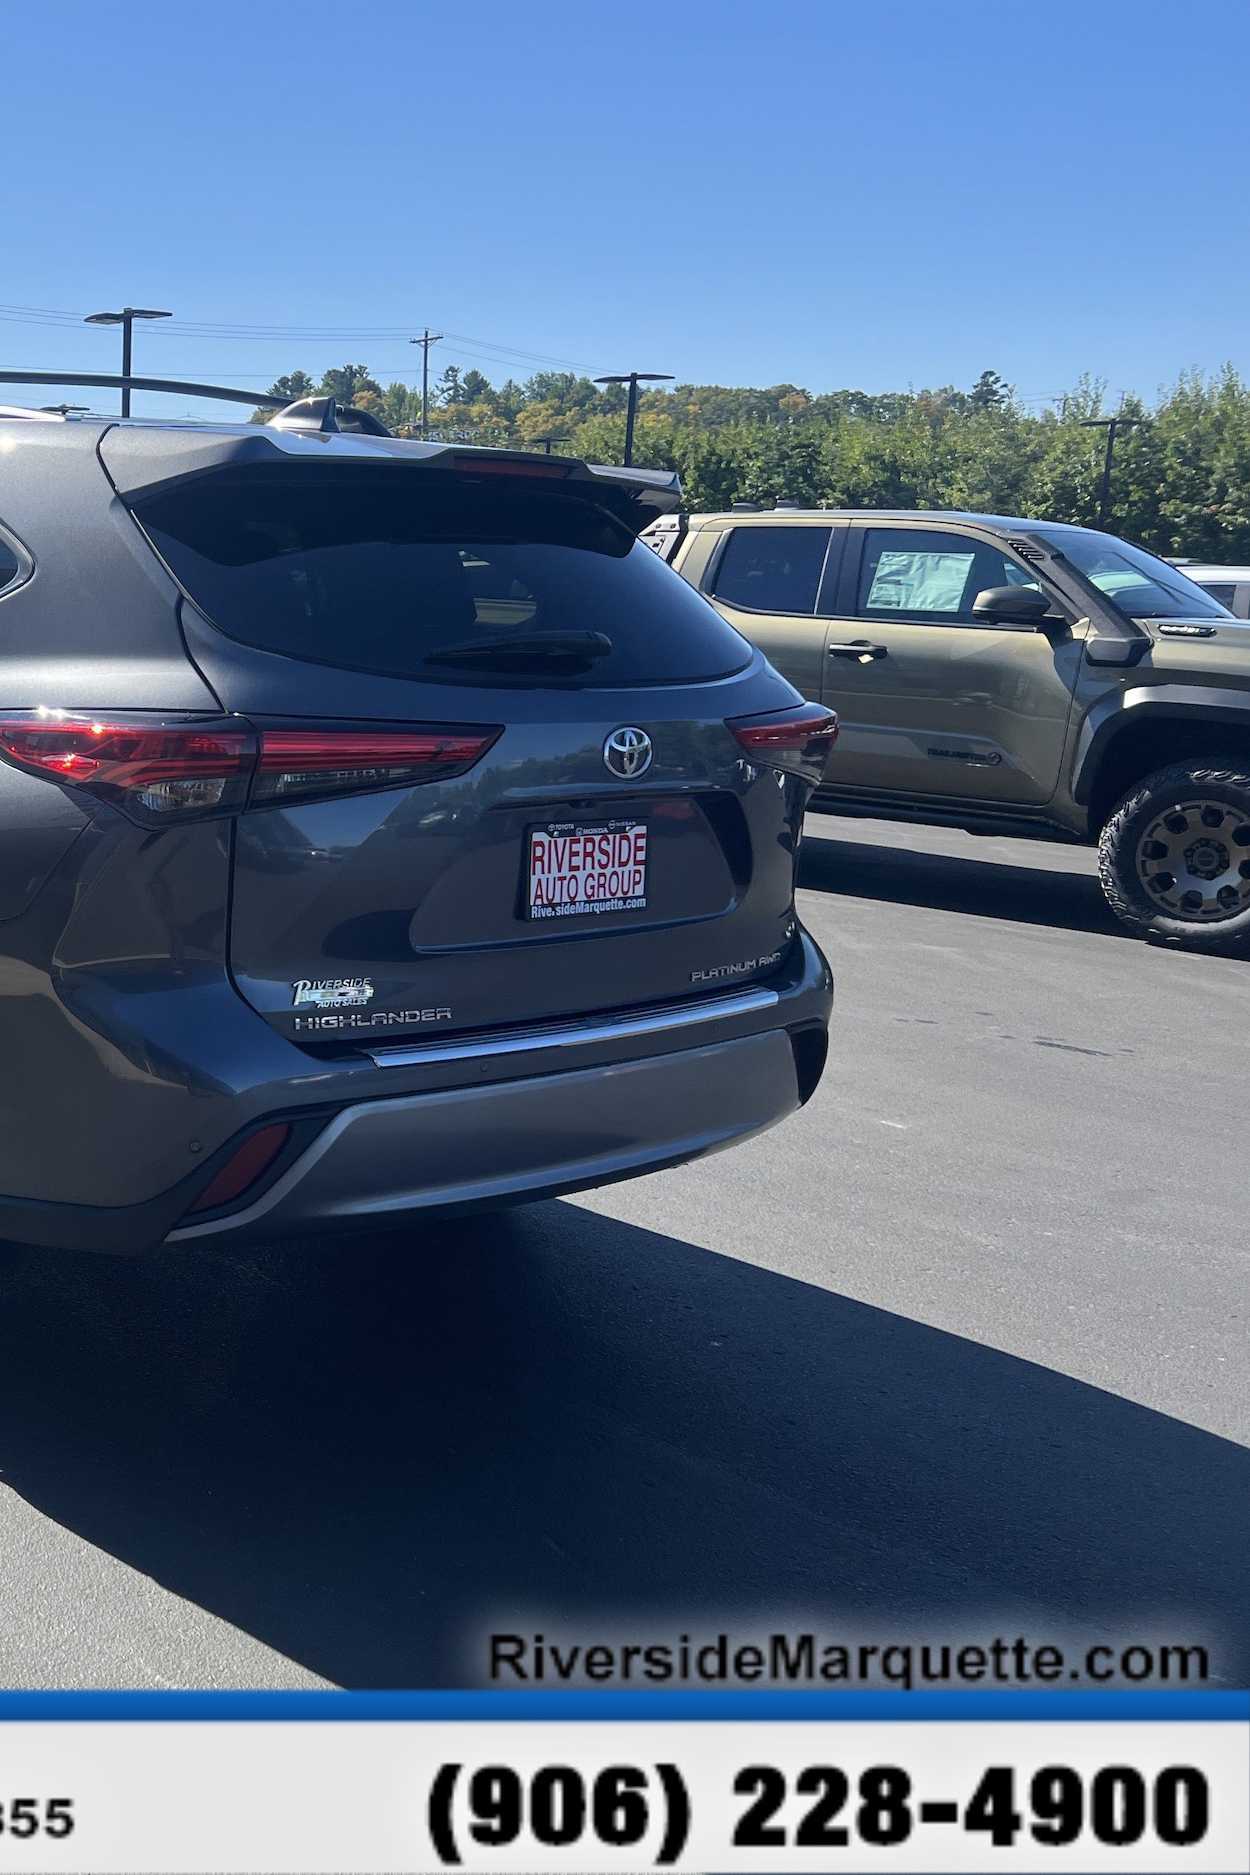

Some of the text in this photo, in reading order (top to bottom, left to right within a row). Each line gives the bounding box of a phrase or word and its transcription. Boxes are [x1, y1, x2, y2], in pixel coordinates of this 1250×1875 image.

[555, 823, 575, 831] TOYOTA
[582, 827, 609, 835] HONDA
[532, 833, 646, 876] RIVERSIDE
[533, 869, 643, 906] AUTO GROUP
[691, 952, 781, 983] PLATINUM AWD
[293, 977, 372, 1006] RIVERSIDE
[294, 1007, 452, 1031] HIGHLANDER
